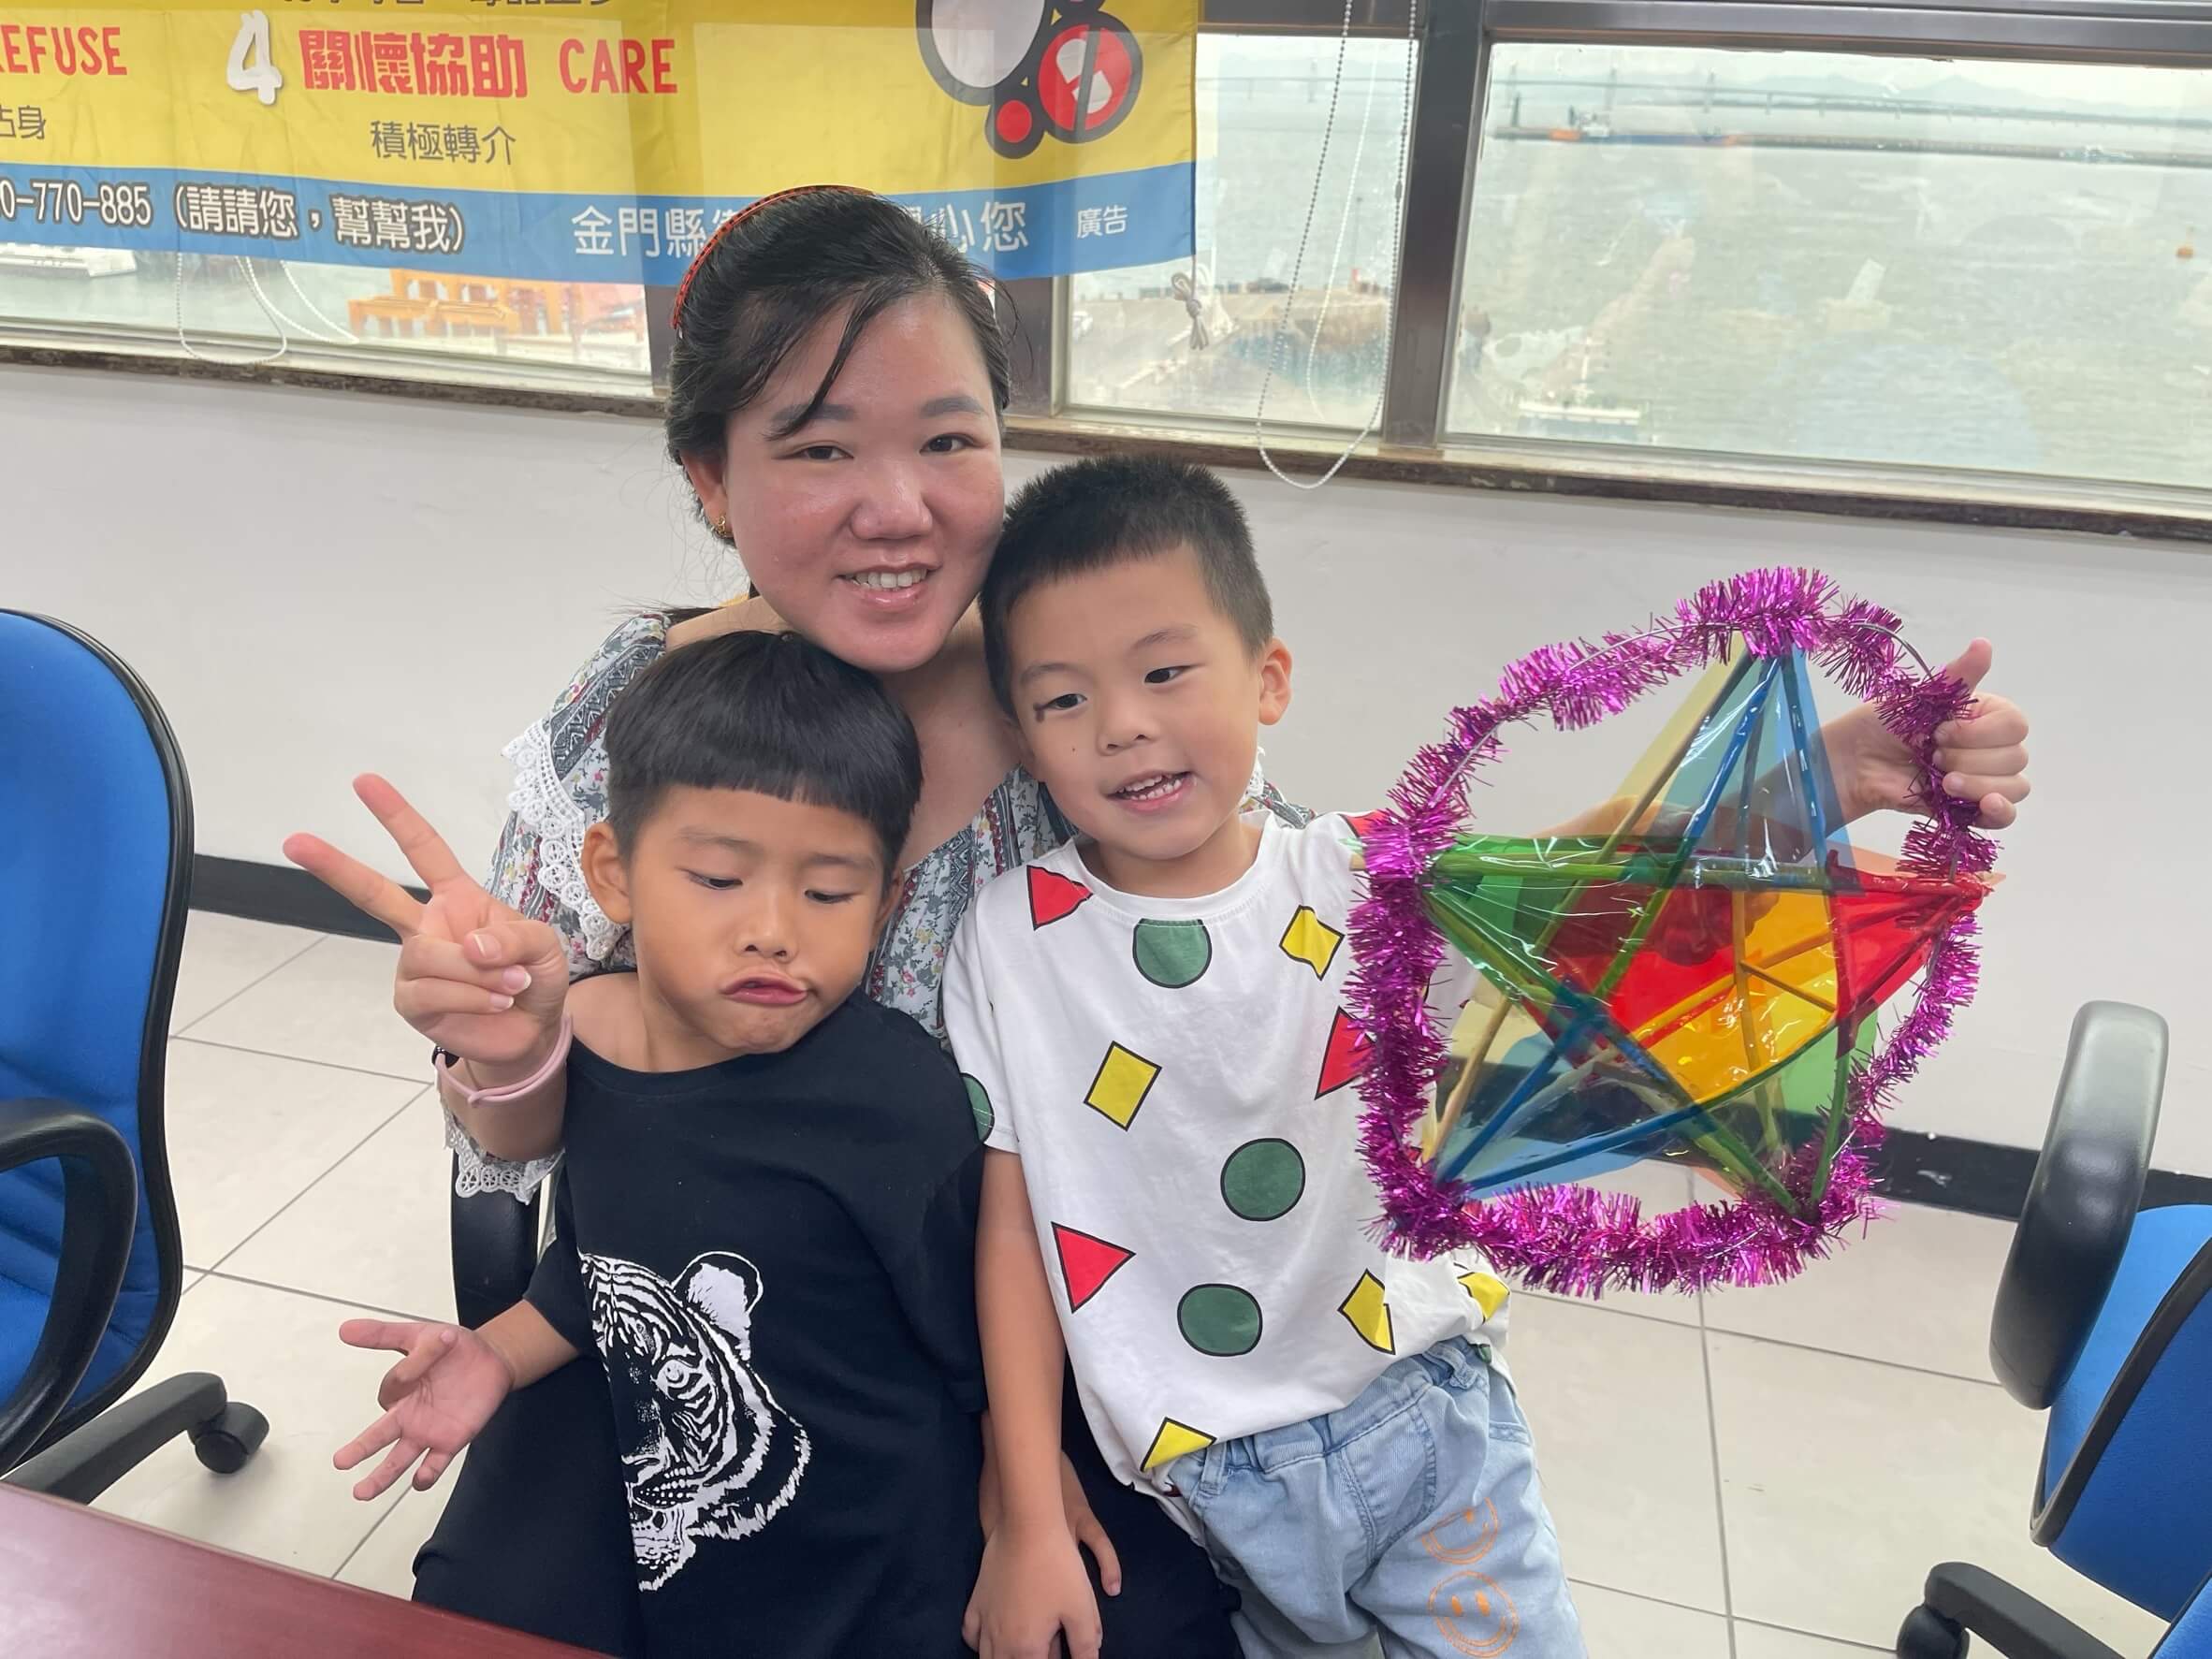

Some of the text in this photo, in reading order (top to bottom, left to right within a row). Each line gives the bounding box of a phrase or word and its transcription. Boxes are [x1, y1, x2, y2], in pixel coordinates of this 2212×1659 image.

[0, 24, 128, 77] EFUSE
[226, 9, 678, 106] 4 關懷協助 CARE
[370, 121, 517, 166] 積極轉介
[1076, 204, 1128, 240] 廣告
